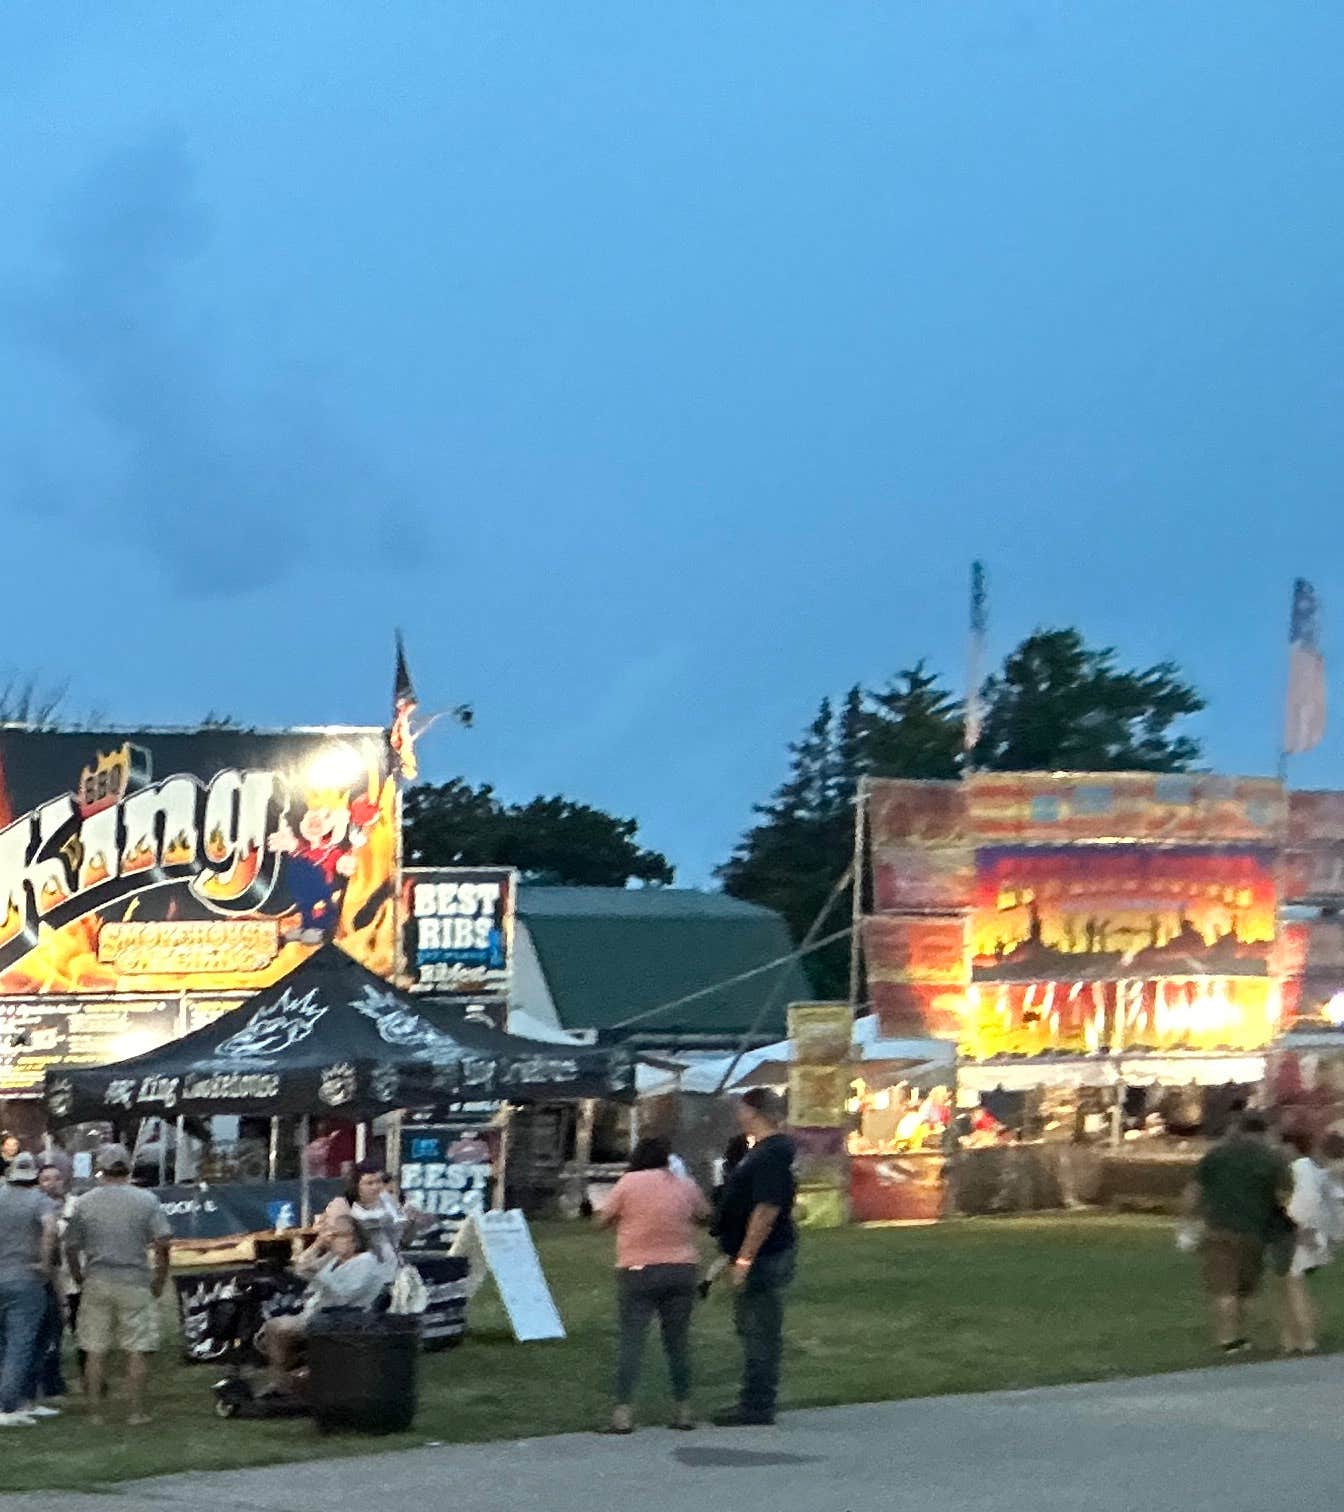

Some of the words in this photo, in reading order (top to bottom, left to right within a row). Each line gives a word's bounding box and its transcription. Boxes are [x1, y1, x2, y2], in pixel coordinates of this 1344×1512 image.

[414, 882, 500, 917] BEST
[418, 917, 495, 950] RIBS
[401, 1162, 493, 1190] BEST
